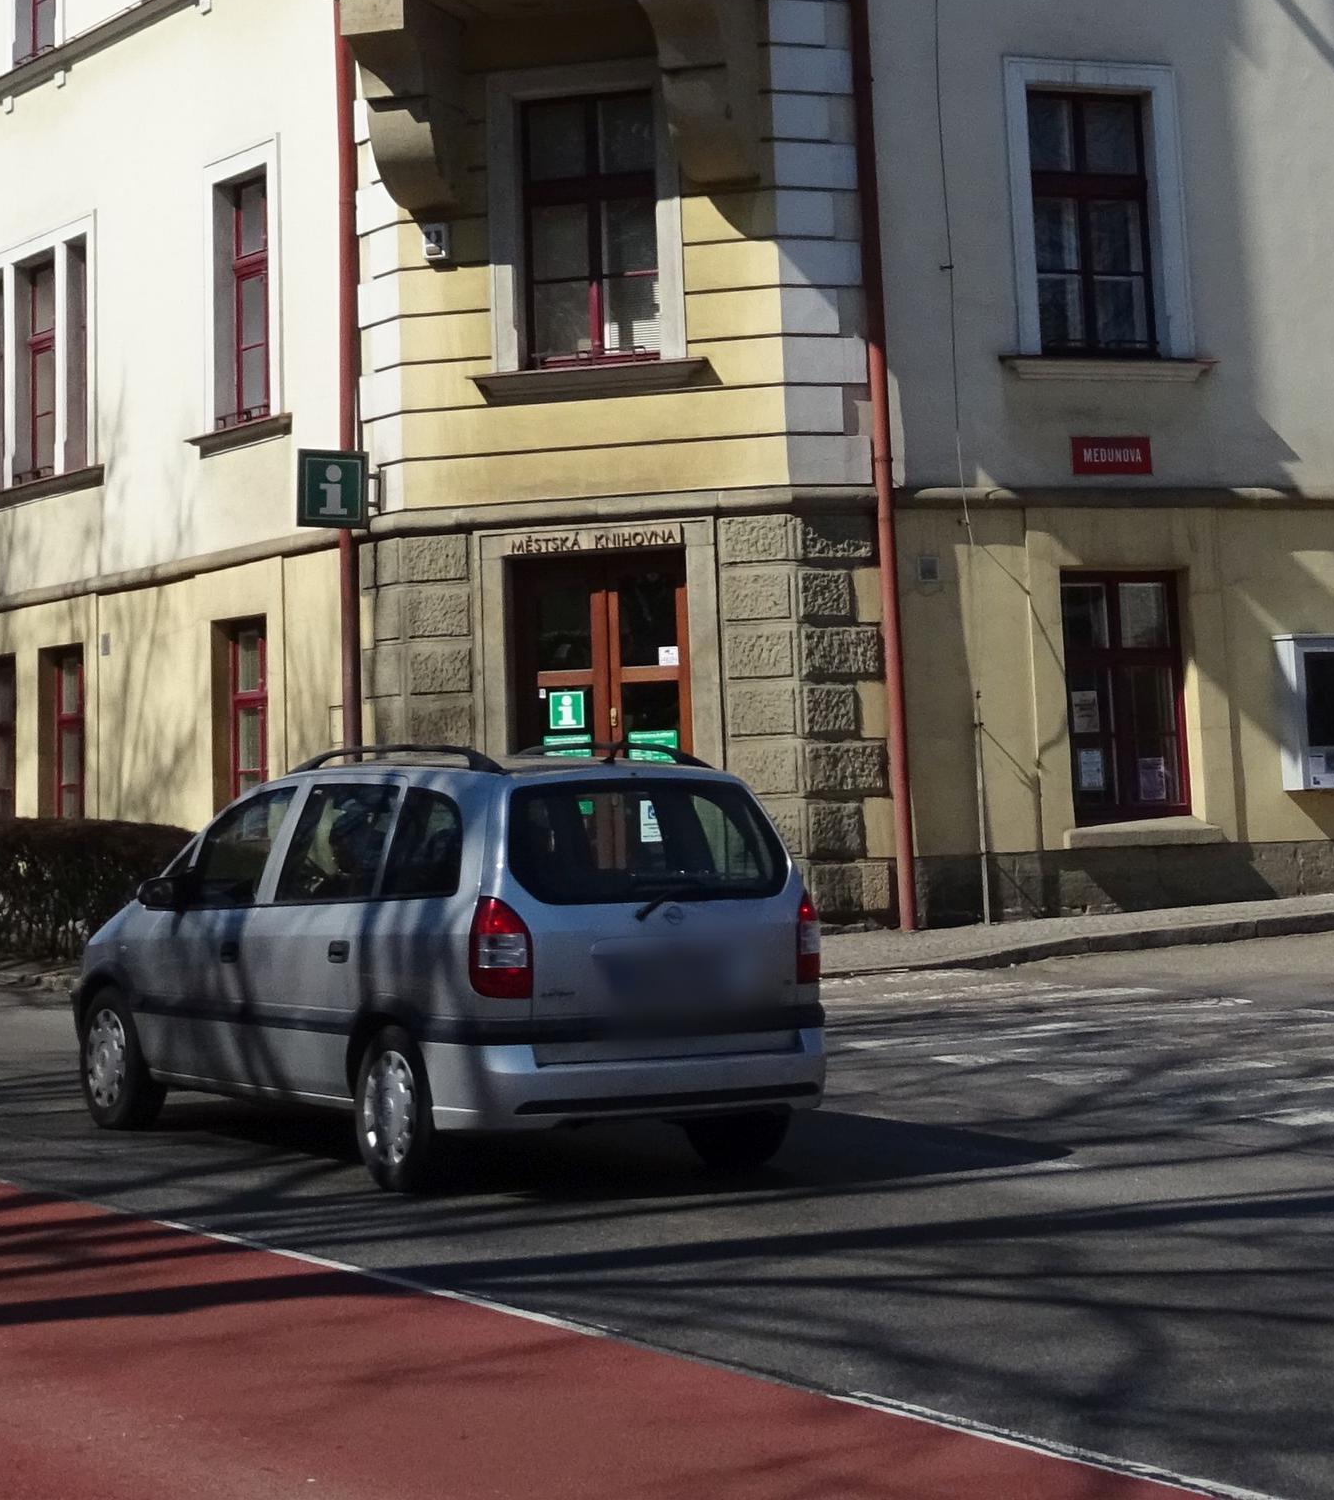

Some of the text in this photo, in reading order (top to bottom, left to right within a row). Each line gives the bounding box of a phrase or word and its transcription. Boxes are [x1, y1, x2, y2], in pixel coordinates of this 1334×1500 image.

[1083, 447, 1142, 463] MEDUNOVA
[511, 528, 676, 554] MĚSTSKÁ KNIHOVNA
